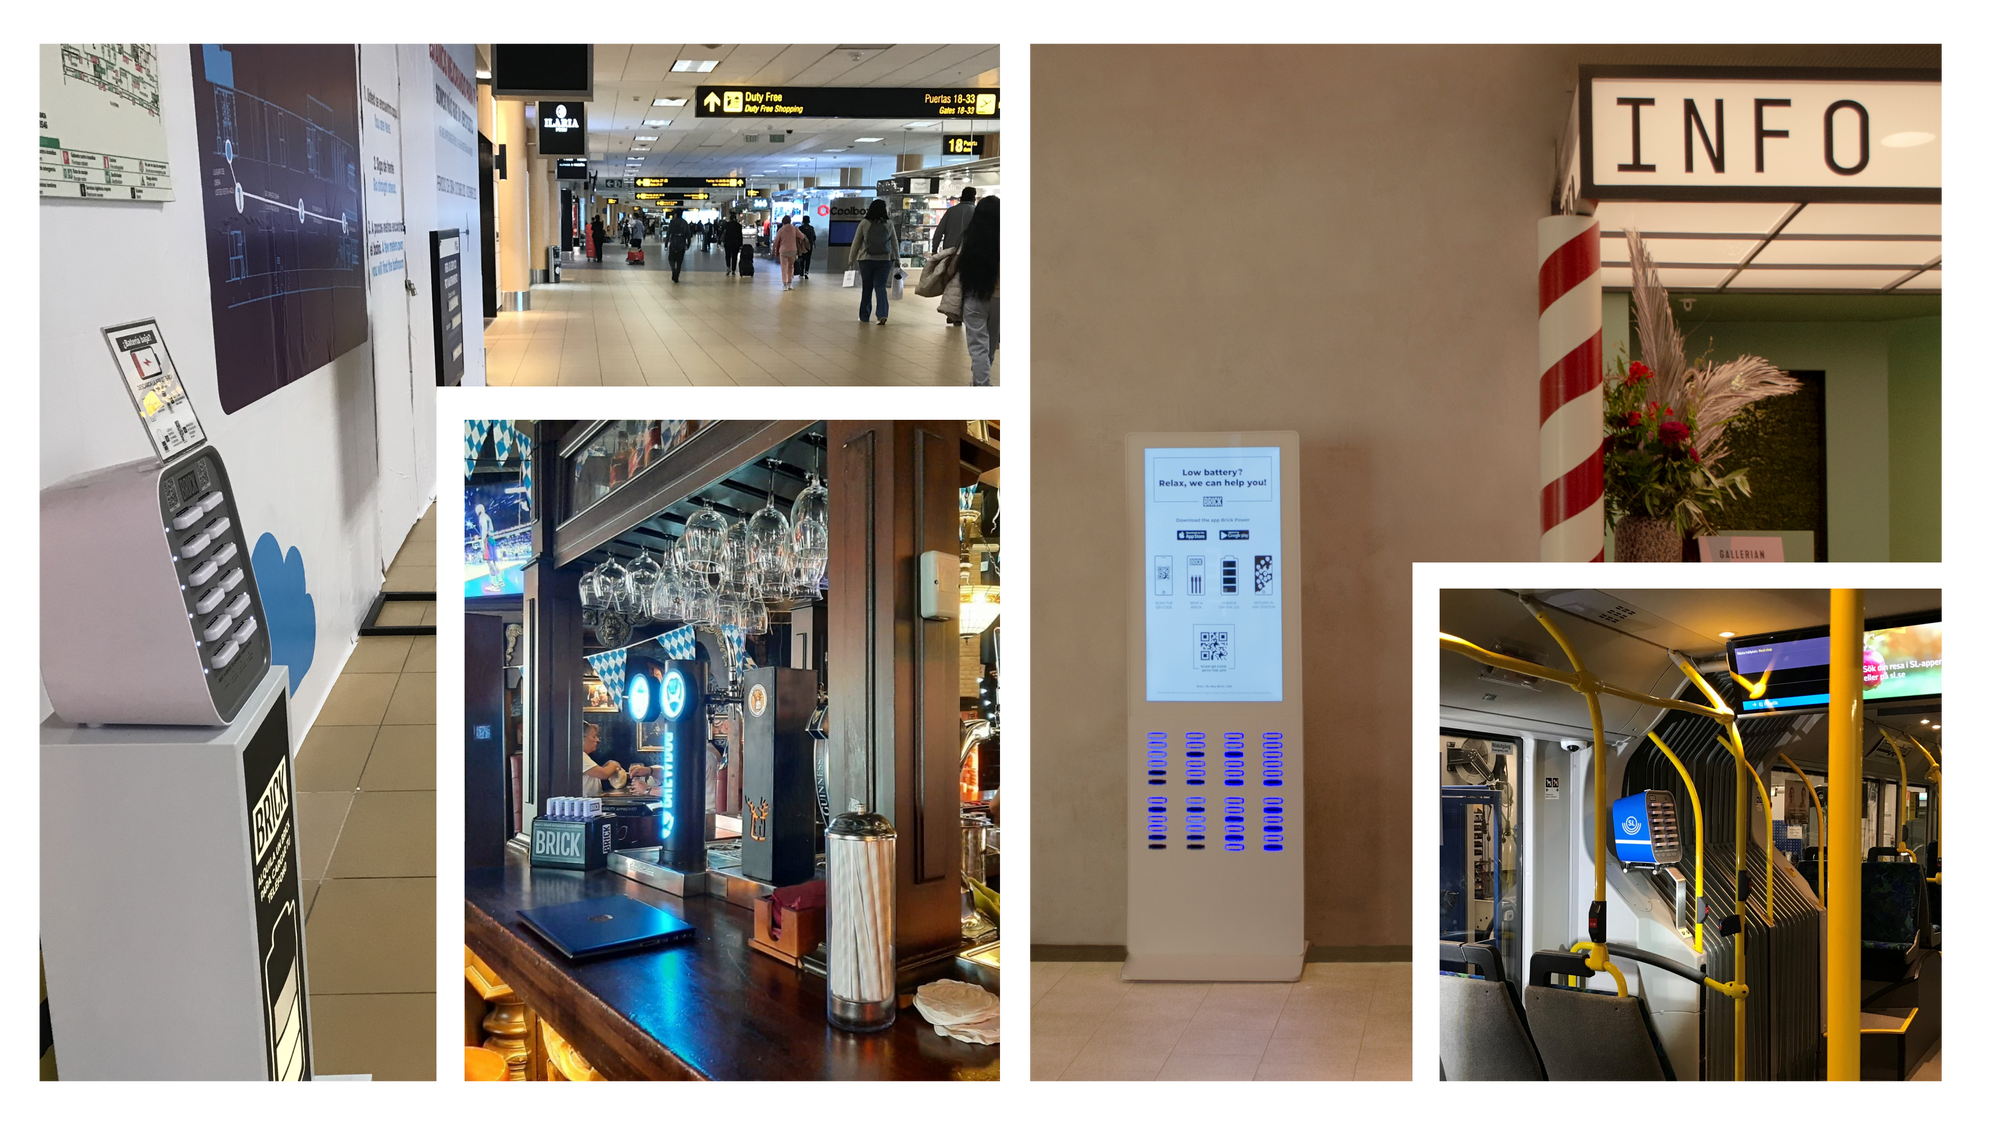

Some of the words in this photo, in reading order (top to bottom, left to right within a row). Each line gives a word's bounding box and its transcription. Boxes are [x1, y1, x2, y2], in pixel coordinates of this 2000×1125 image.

[745, 91, 763, 103] Duty
[766, 92, 782, 102] Free
[924, 94, 952, 104] Puertas
[954, 94, 976, 104] 18-33
[744, 104, 760, 114] Duty
[760, 104, 774, 112] Free
[774, 104, 804, 114] Shopping
[544, 118, 580, 128] ILARIA
[1616, 97, 1870, 176] INFO
[948, 138, 963, 152] 18
[830, 206, 868, 215] Coolbo
[1204, 468, 1243, 478] battery?
[1159, 480, 1187, 488] Relax,
[1224, 479, 1244, 488] help
[1247, 479, 1267, 488] you!
[1204, 497, 1222, 506] BRICK
[1719, 550, 1765, 559] GALLERIAN
[1880, 673, 1888, 681] på
[816, 758, 829, 816] GUINNESS
[254, 763, 287, 856] BRICK
[536, 830, 581, 857] BRICK
[603, 824, 611, 854] BRICK
[258, 852, 276, 889] ALQUILA
[260, 876, 272, 902] PARA
